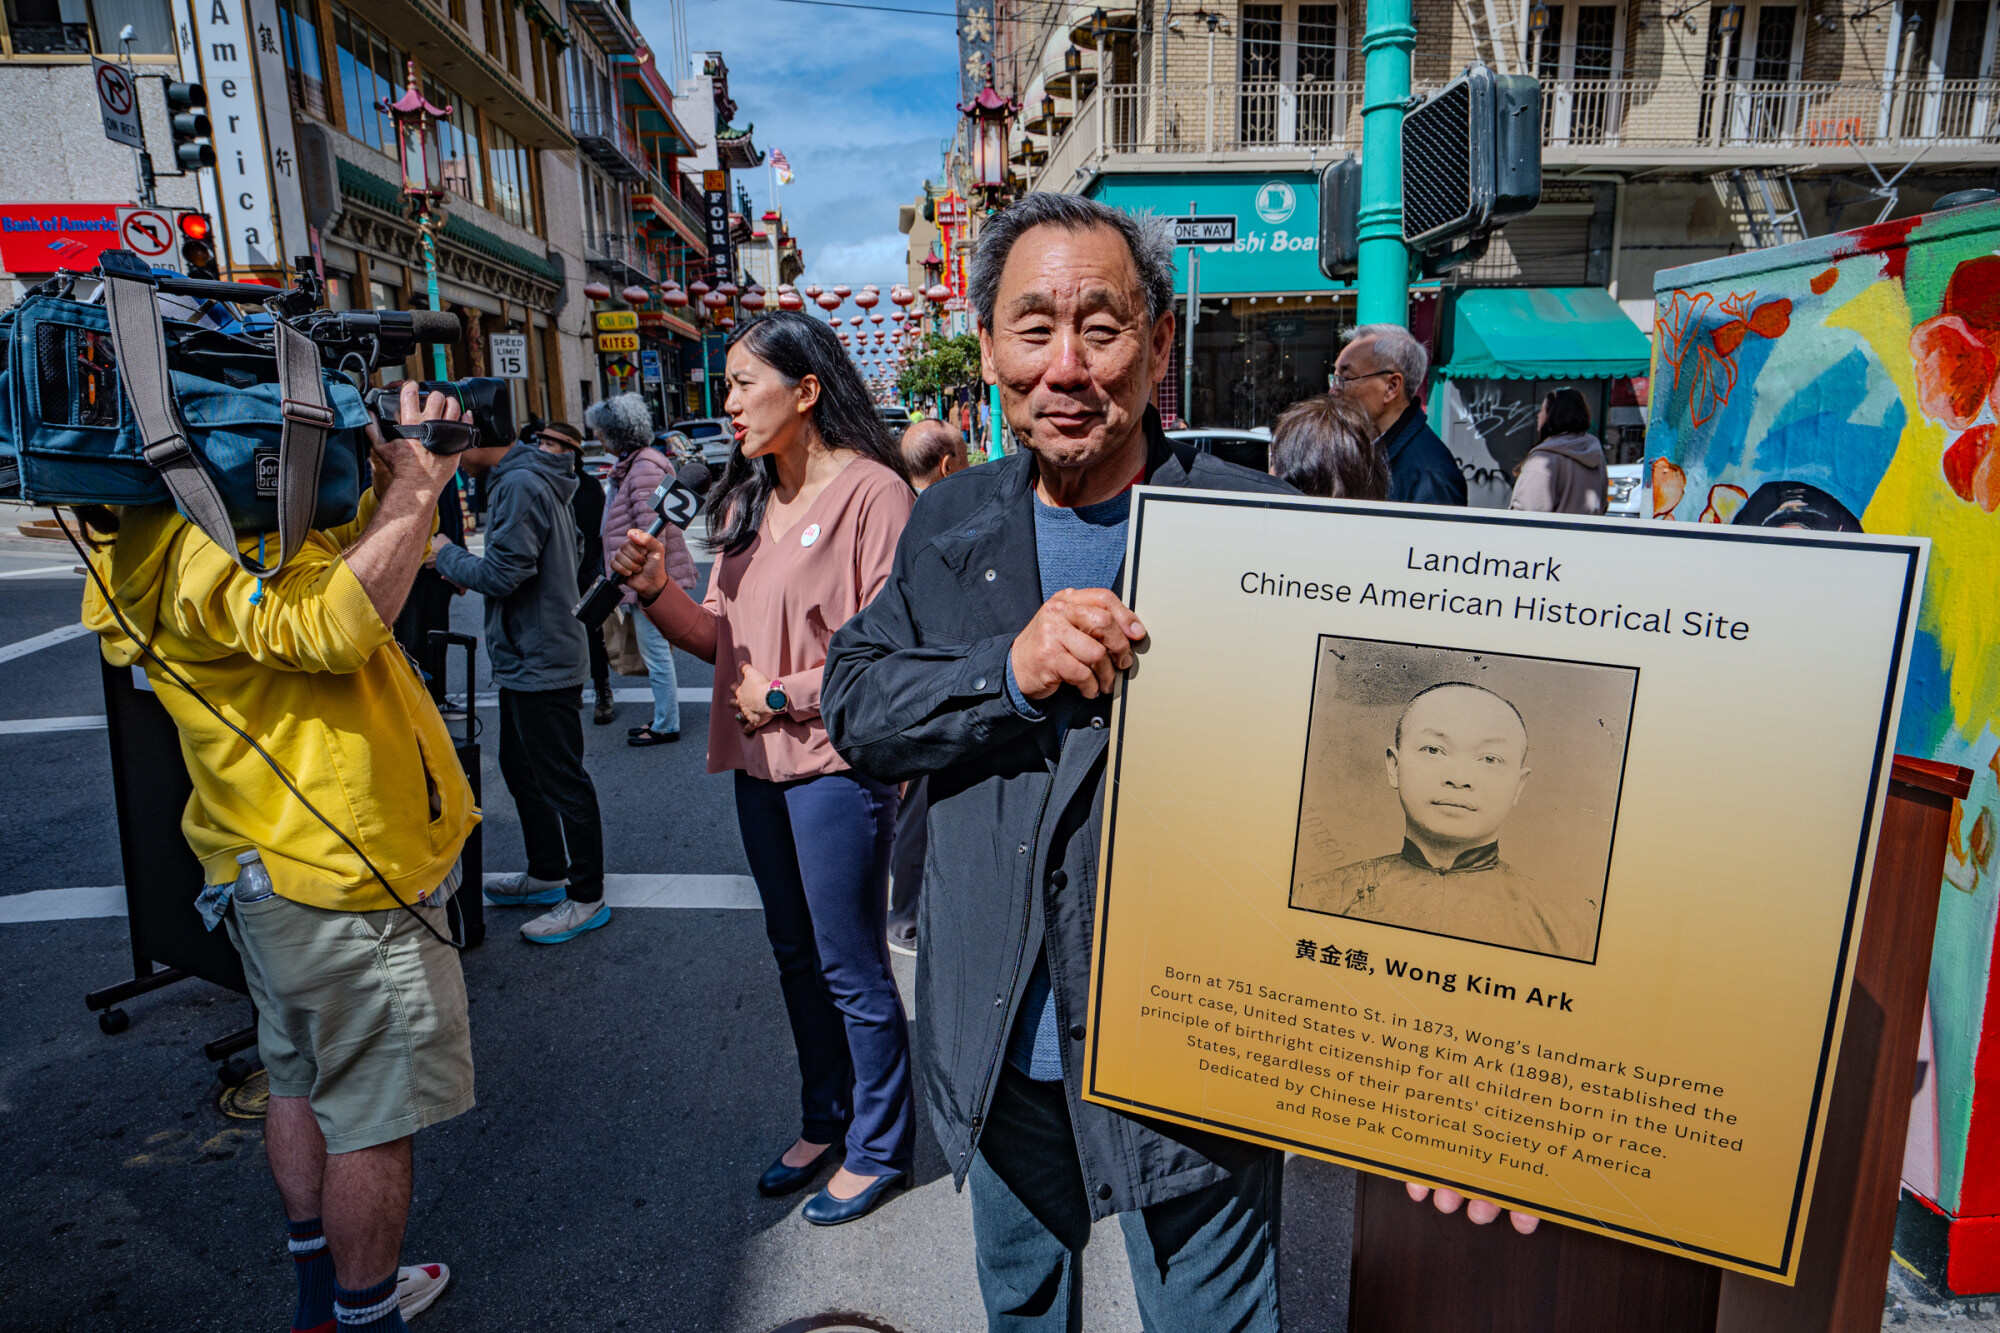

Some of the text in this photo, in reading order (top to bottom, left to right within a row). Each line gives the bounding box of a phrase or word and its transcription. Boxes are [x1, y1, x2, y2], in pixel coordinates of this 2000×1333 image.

[210, 0, 260, 245] America
[2, 215, 119, 233] Bank of Americ
[710, 192, 725, 245] FOUR
[1174, 223, 1229, 238] ONE WAY
[1203, 231, 1266, 254] shi
[494, 337, 523, 347] SPEED
[496, 347, 521, 356] LIMIT
[499, 357, 522, 375] 15
[601, 336, 635, 349] KITES
[1407, 546, 1562, 583] Landmark
[1240, 571, 1750, 641] Chinese American Historical Site
[1384, 957, 1458, 993] Wong
[1466, 973, 1517, 1001] Kim
[1524, 986, 1575, 1013] Ark
[1150, 984, 1738, 1126] Court case, United States v. Wong Kim Ark (1898), established the
[1165, 965, 1201, 985] Born
[1205, 977, 1223, 989] at
[1227, 978, 1253, 996] 751
[1258, 985, 1358, 1017] Sacramento
[1363, 1007, 1385, 1024] St.
[1391, 1012, 1408, 1029] in
[1412, 1018, 1459, 1042] 1873,
[1536, 1043, 1628, 1077] landmark
[1631, 1065, 1725, 1098] Supreme
[1140, 1005, 1744, 1153] principle of birthright citizenship for all children born in the United
[1186, 1034, 1667, 1159] States, regardless of their parents' citizenship or race.
[1199, 1057, 1652, 1180] Dedicated by Chinese Historical Society of America
[1275, 1100, 1549, 1177] and Rose Pak Community Fund.
